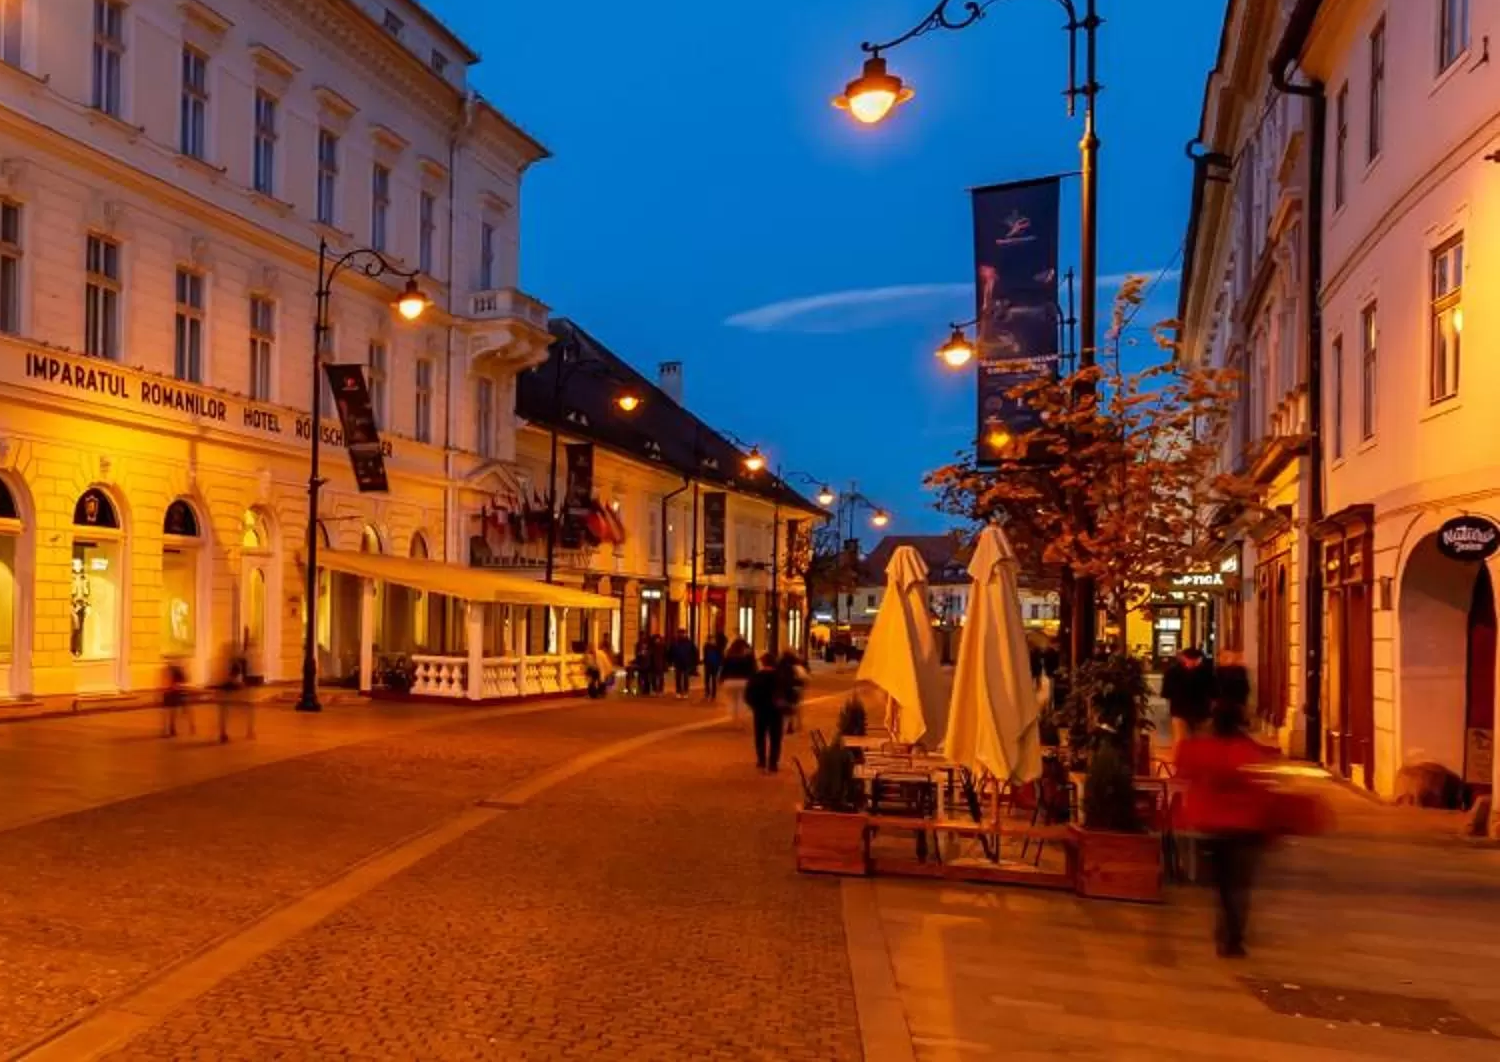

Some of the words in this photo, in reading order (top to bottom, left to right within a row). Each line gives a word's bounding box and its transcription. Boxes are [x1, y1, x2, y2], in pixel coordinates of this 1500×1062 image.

[26, 353, 129, 399] IMPARATUL
[141, 381, 227, 422] ROMANILOR
[243, 407, 281, 433] HOTEL
